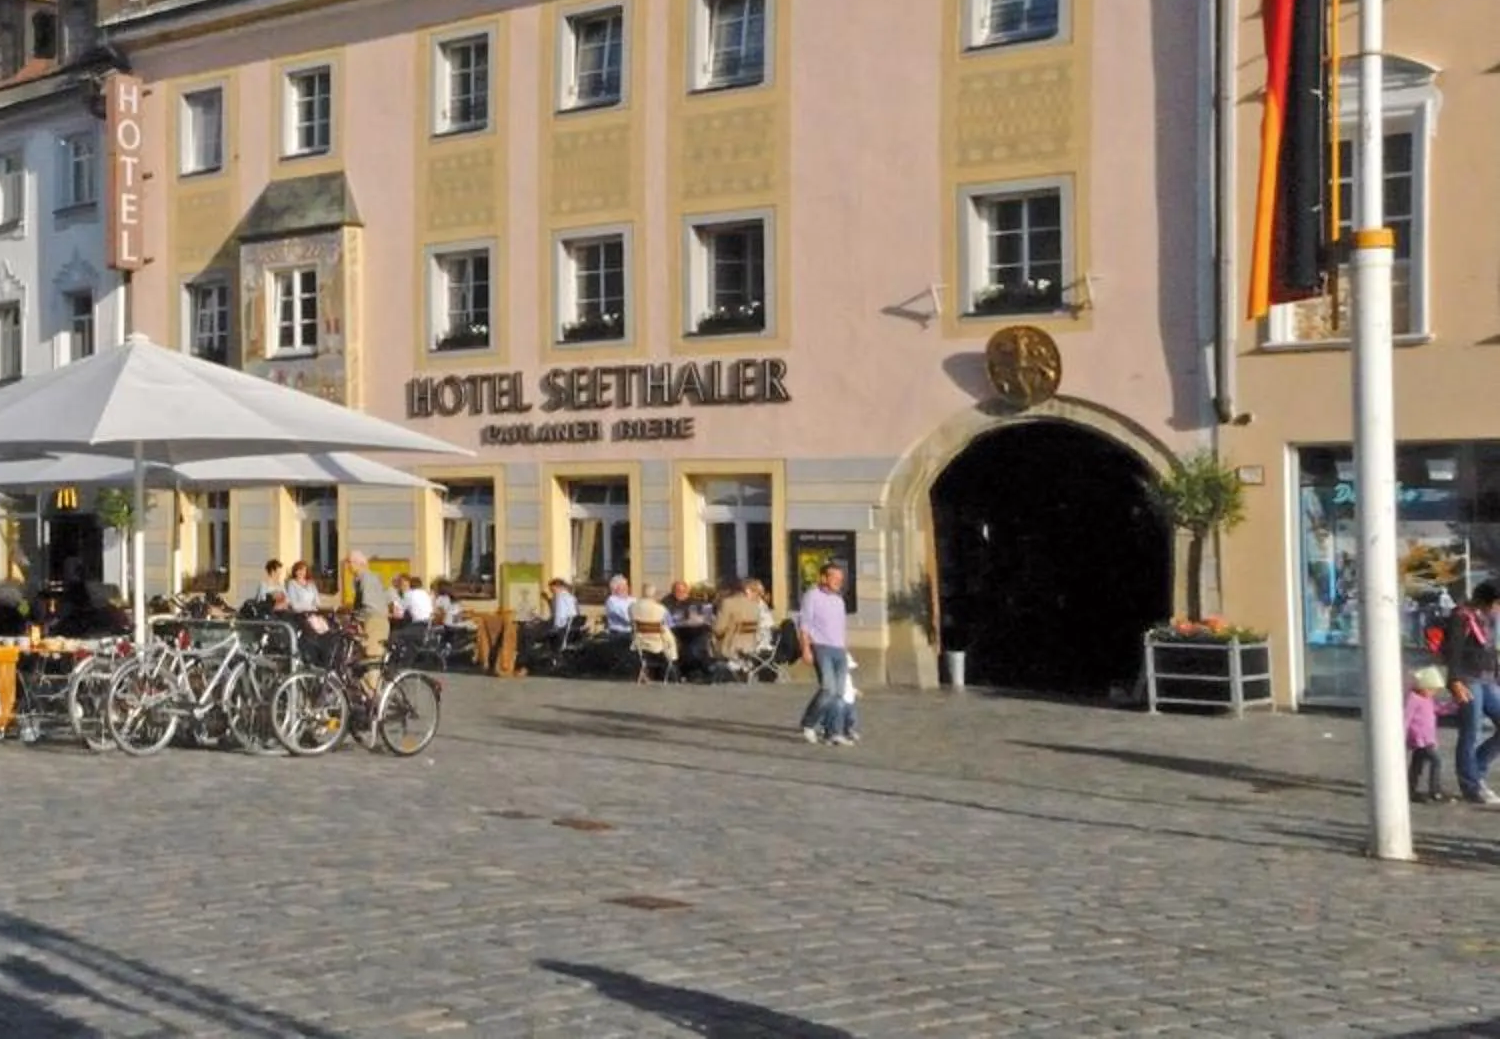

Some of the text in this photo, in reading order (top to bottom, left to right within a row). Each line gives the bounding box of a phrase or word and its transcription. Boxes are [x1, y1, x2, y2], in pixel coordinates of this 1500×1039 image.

[116, 83, 141, 261] HOTEL
[406, 358, 791, 418] HOTEL SEETHALER
[480, 419, 603, 446] PAULANER
